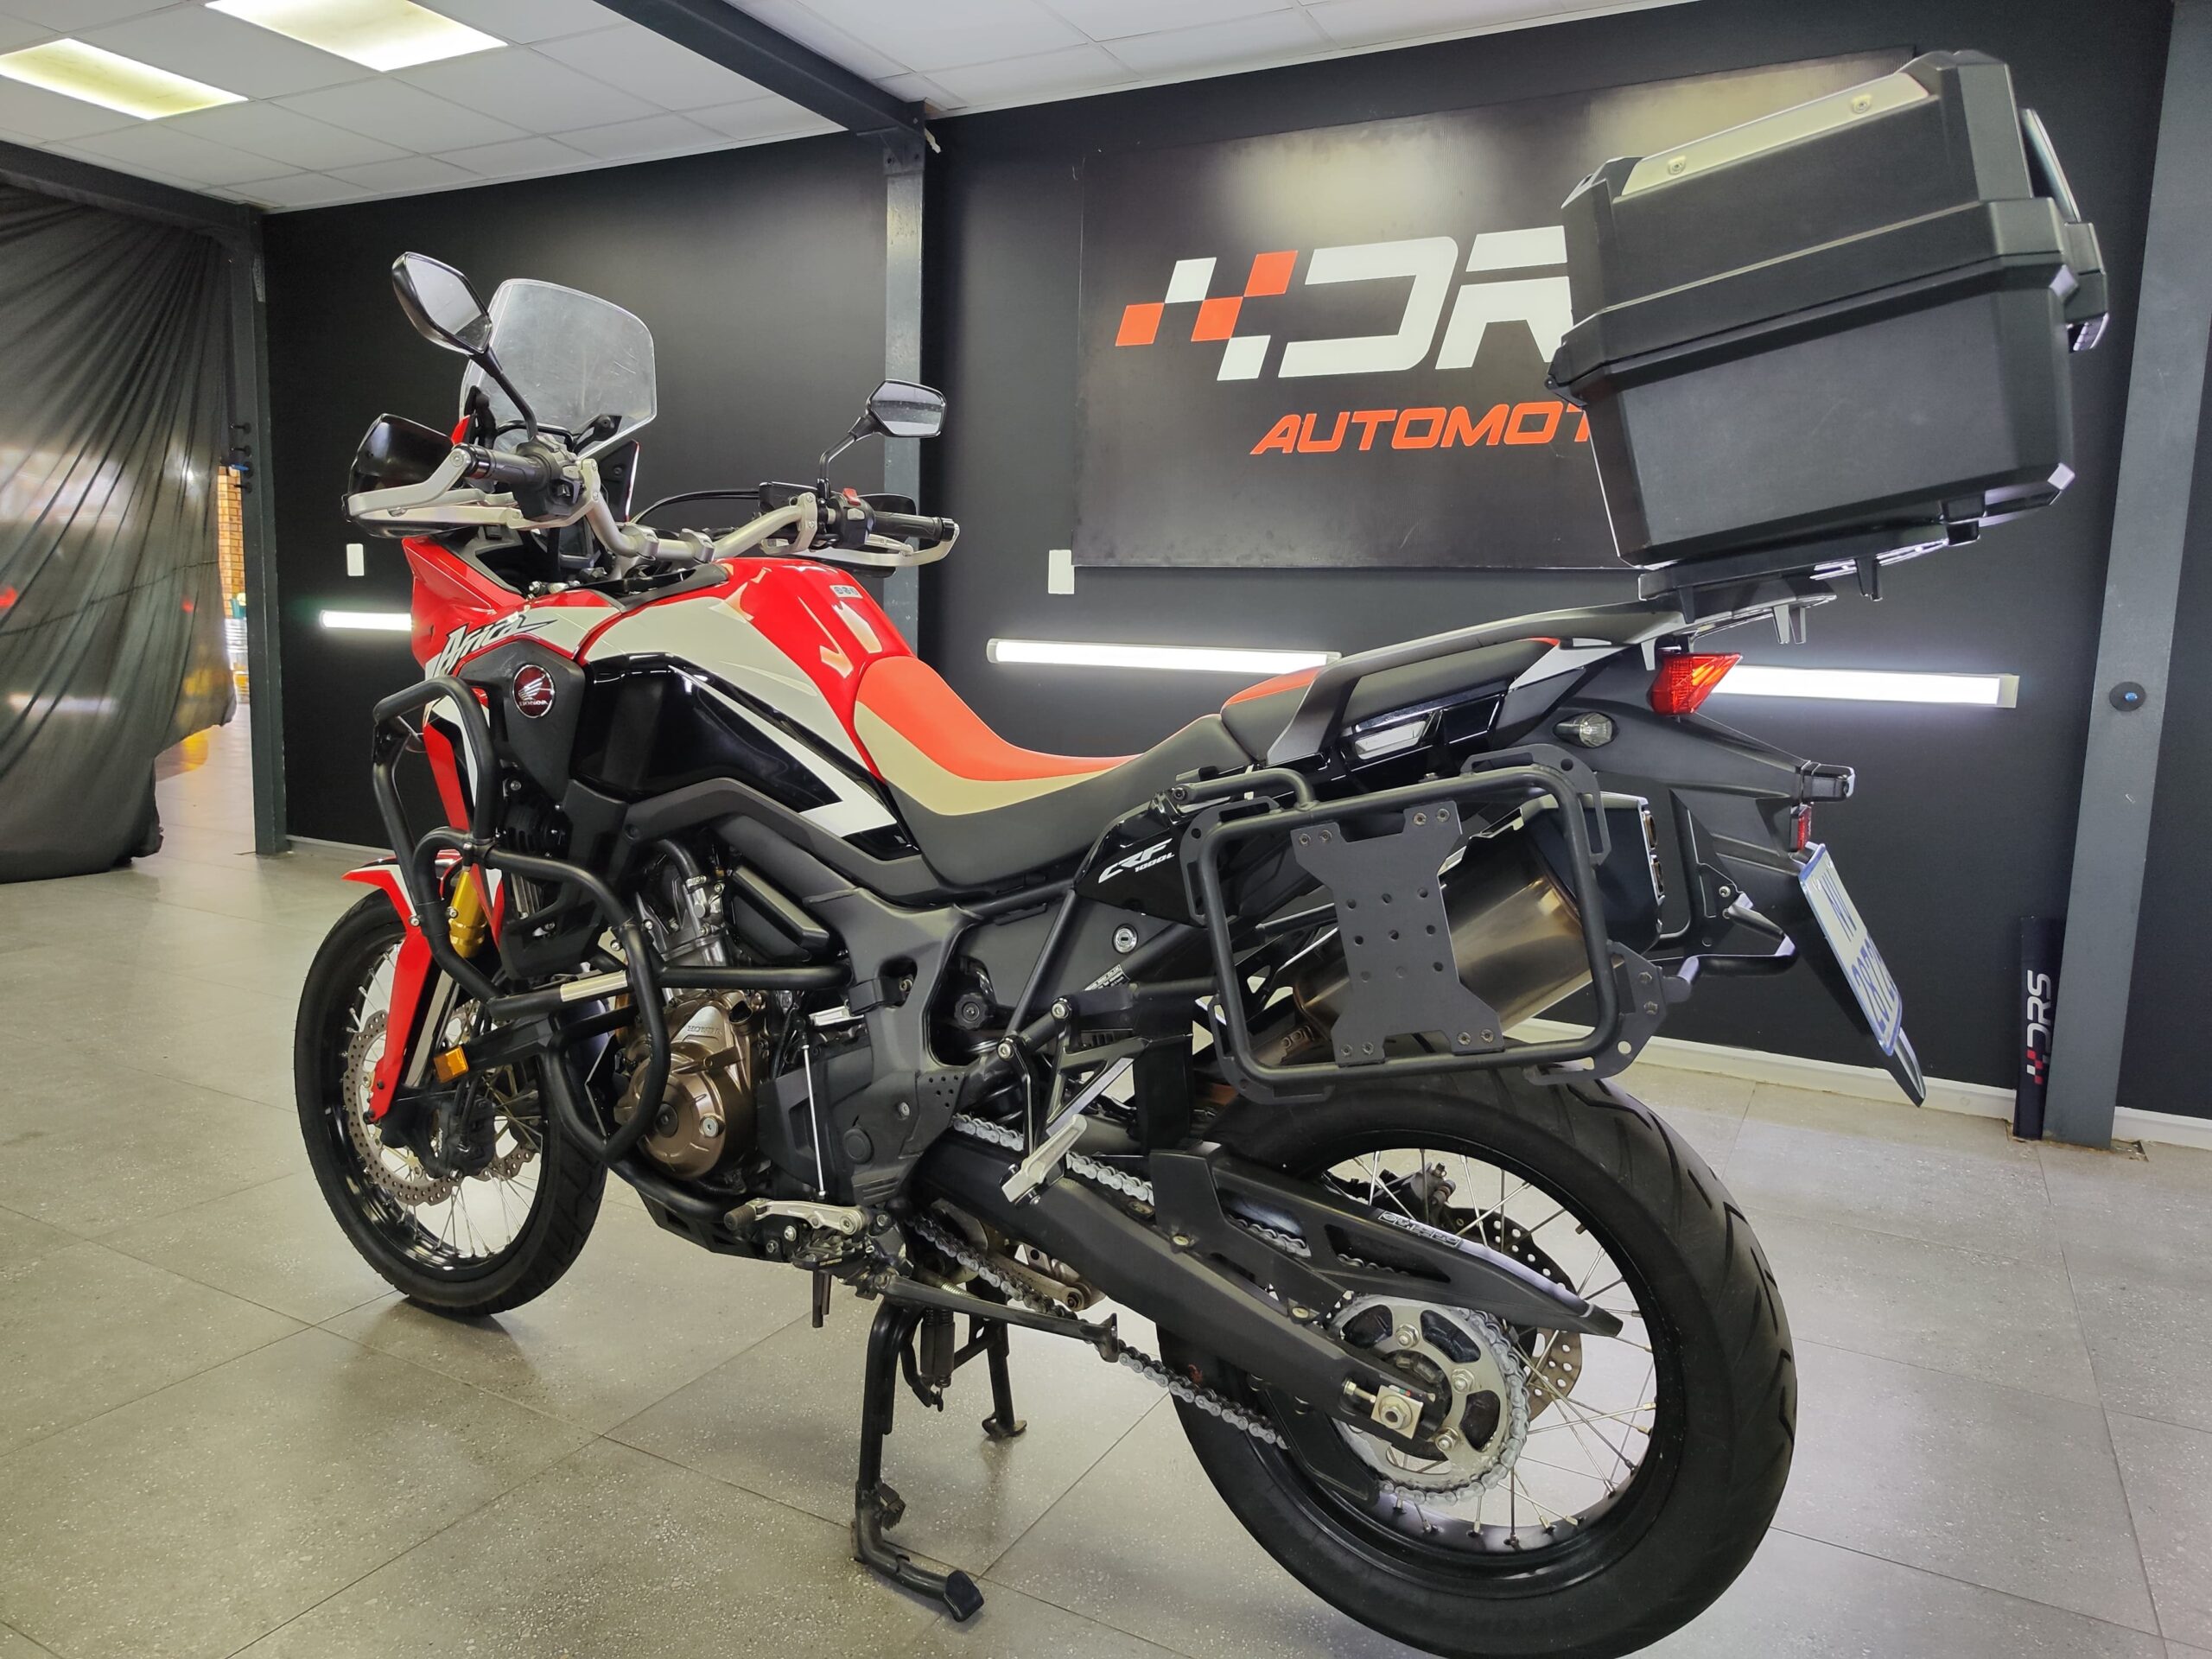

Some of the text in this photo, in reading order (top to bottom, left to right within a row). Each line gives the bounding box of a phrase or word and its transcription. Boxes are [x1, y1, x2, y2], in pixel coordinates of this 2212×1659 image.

[1098, 837, 1173, 884] CRF
[1135, 852, 1175, 873] 1000L
[2027, 969, 2052, 1055] DRS
[687, 1025, 723, 1035] HONDA
